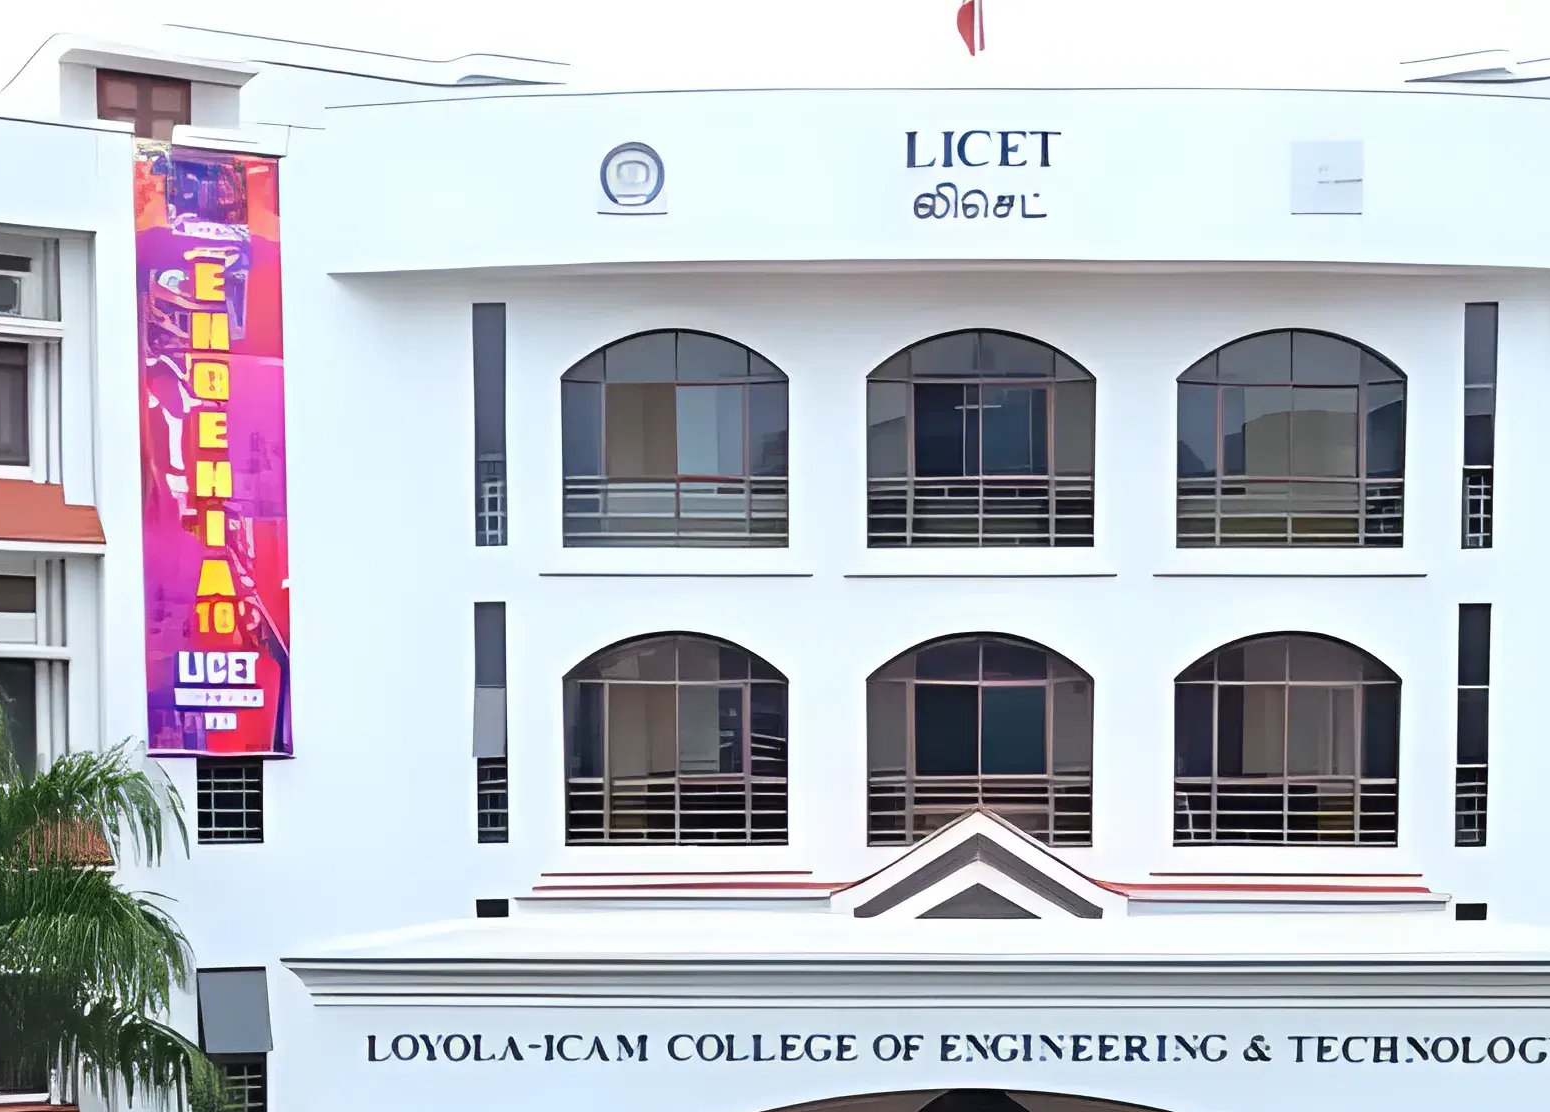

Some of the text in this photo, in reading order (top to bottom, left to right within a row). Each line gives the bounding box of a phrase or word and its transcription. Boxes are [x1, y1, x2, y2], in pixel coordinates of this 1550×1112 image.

[905, 130, 1062, 169] LICET
[913, 181, 1049, 220] லிசெட்
[366, 1033, 649, 1063] LOYOLA-ICAM
[666, 1033, 859, 1062] COLLEGE
[871, 1033, 925, 1062] OF
[939, 1033, 1229, 1063] ENGINEERING
[1241, 1034, 1273, 1063] &
